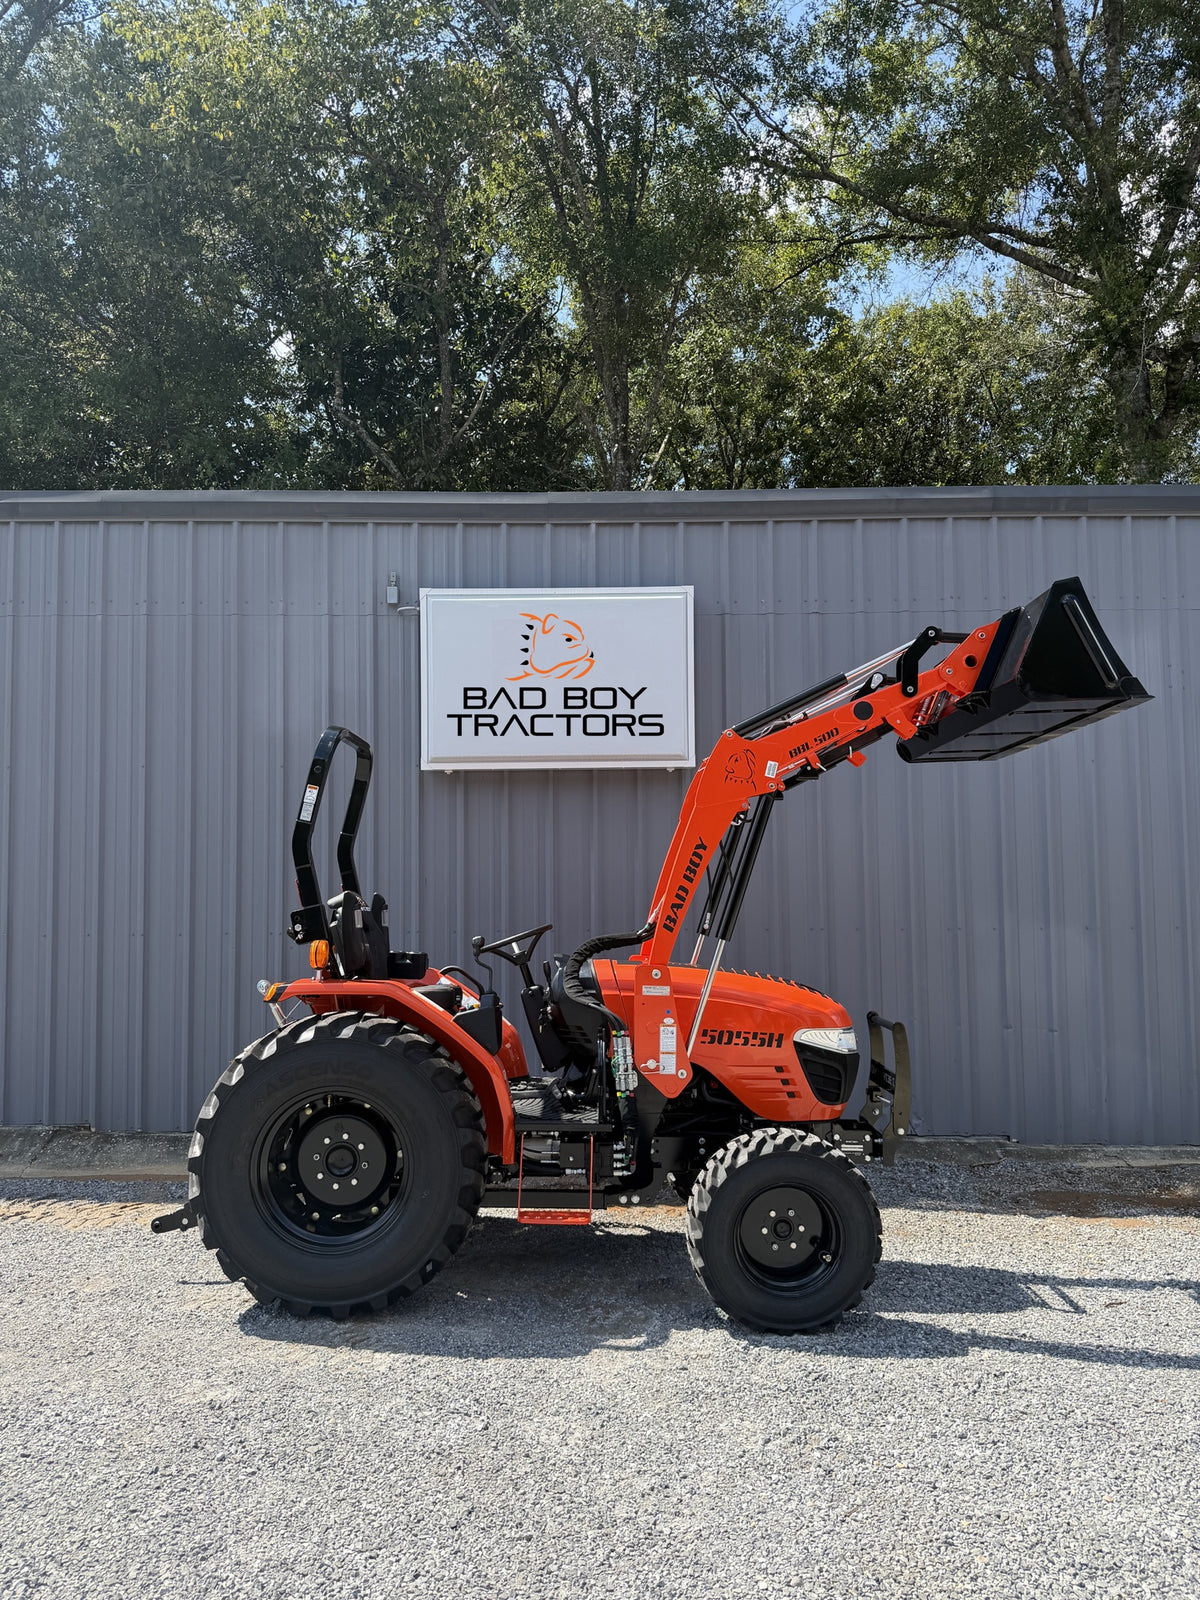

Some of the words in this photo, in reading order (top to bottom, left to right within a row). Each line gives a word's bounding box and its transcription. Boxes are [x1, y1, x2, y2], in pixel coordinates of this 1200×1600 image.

[463, 686, 547, 710] BAD
[563, 686, 648, 710] BOY
[446, 713, 665, 737] TRACTORS
[813, 727, 840, 746] 500
[662, 885, 690, 933] BAD
[682, 836, 708, 884] BOY
[700, 1028, 785, 1049] 5055H
